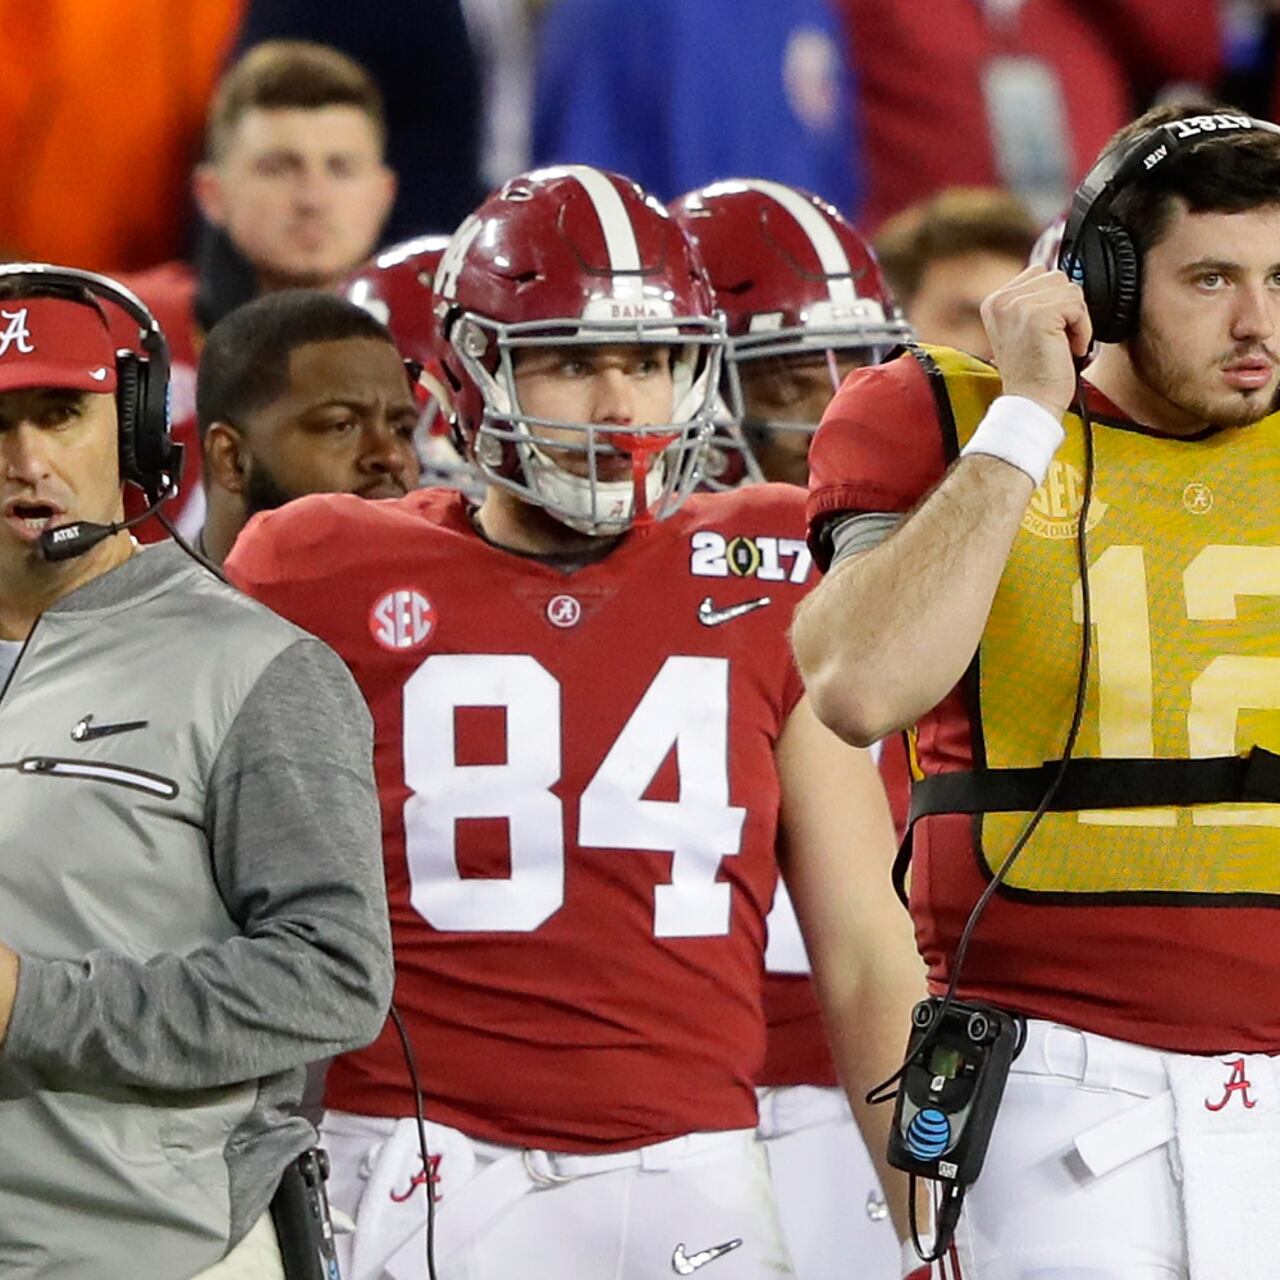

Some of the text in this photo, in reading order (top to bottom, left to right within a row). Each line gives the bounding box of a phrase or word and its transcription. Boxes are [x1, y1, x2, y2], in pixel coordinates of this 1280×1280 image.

[1178, 114, 1252, 138] AT&T
[1143, 144, 1168, 170] AT&T
[611, 303, 659, 319] BAMA
[53, 525, 80, 543] AT&T
[373, 589, 432, 648] SEC
[403, 655, 747, 938] 84
[1204, 1057, 1259, 1112] A
[389, 1151, 444, 1203] A
